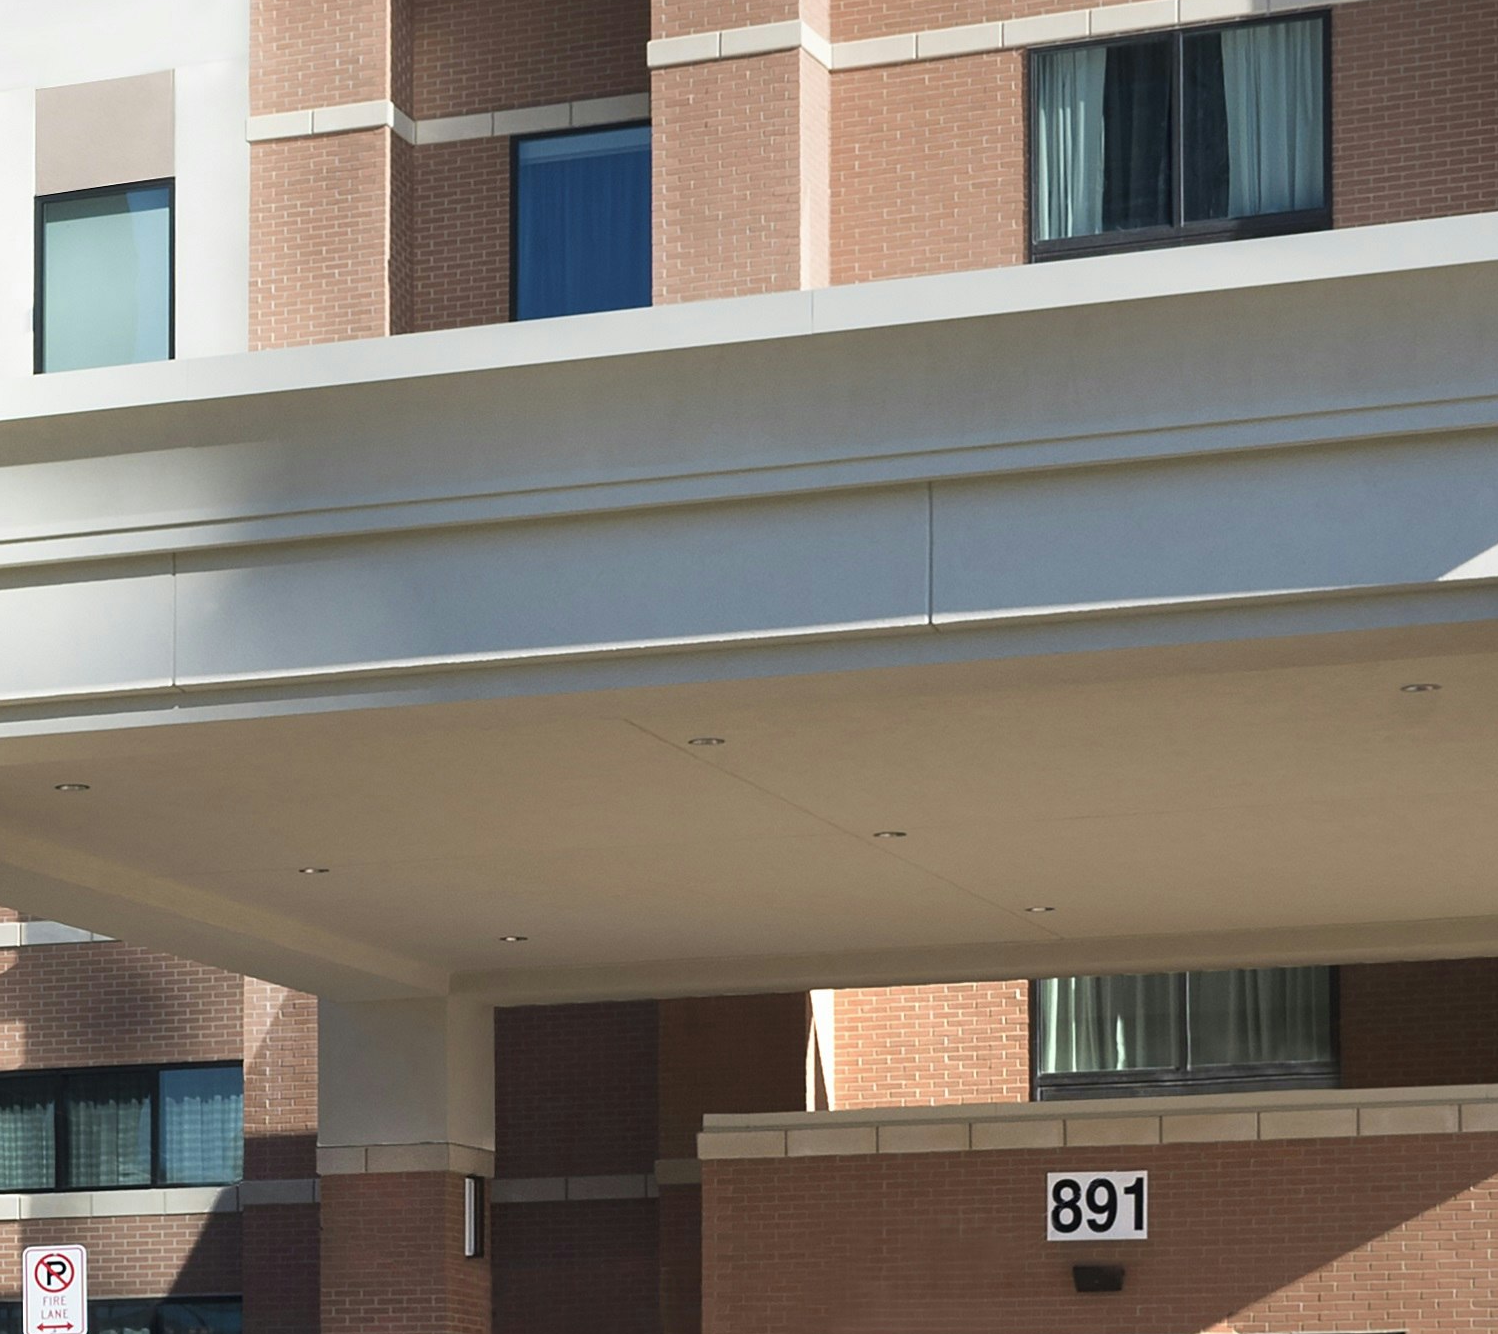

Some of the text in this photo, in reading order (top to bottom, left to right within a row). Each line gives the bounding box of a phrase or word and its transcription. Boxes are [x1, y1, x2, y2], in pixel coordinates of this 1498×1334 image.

[1051, 1177, 1144, 1234] 891
[42, 1295, 67, 1306] FIRE
[40, 1308, 69, 1320] LANE
